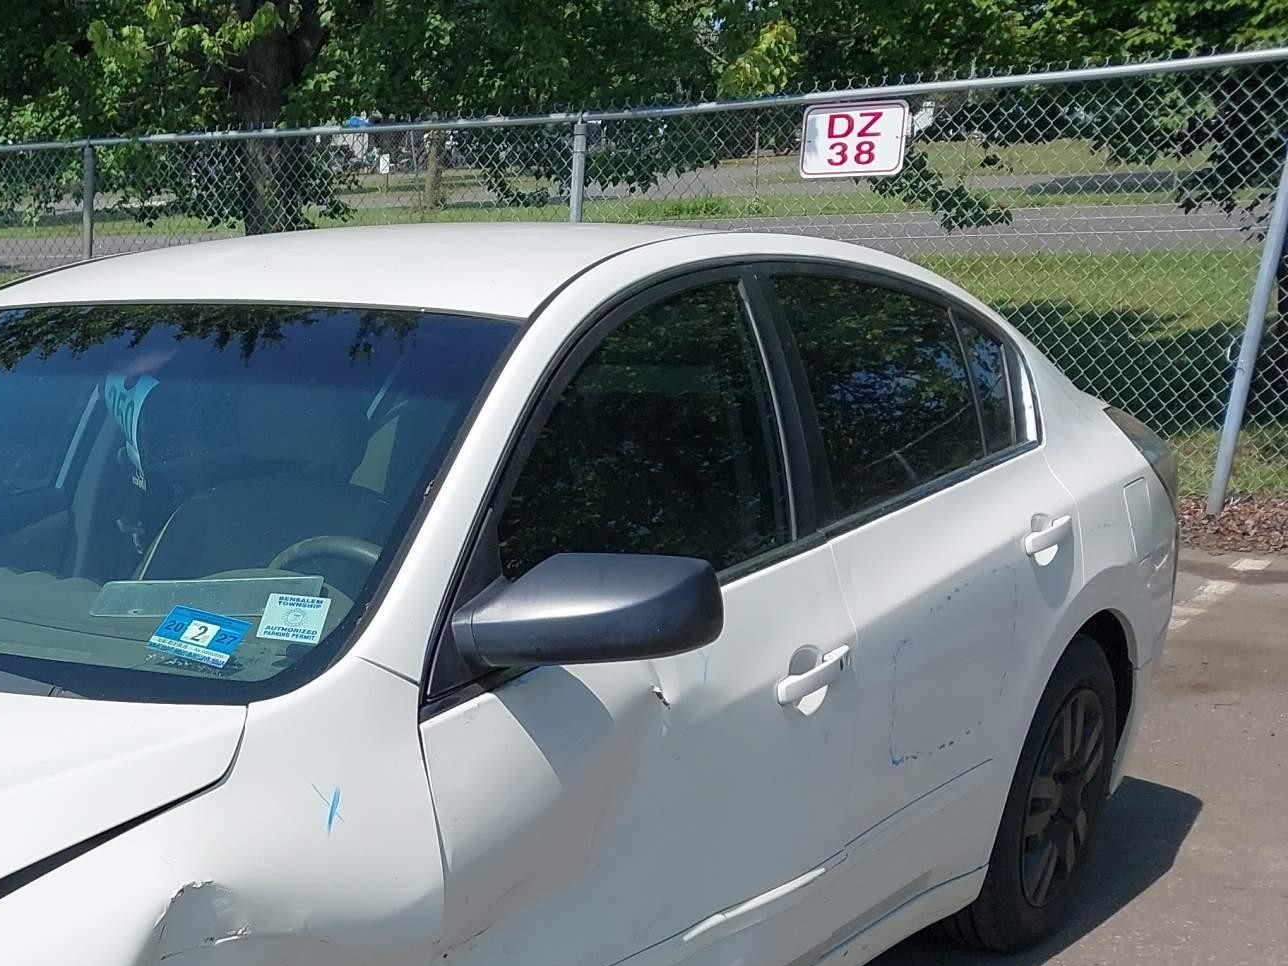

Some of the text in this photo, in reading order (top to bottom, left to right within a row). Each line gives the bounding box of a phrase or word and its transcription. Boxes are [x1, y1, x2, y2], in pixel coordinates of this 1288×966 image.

[827, 111, 883, 139] DZ
[826, 140, 876, 167] 38
[278, 595, 323, 605] BENSALEM
[278, 600, 322, 609] TOWNSHIP
[165, 620, 184, 633] 20
[190, 625, 209, 642] 2
[215, 633, 238, 646] 27
[263, 630, 316, 641] PARKING PERMIT
[265, 625, 318, 635] AUTHORIZED
